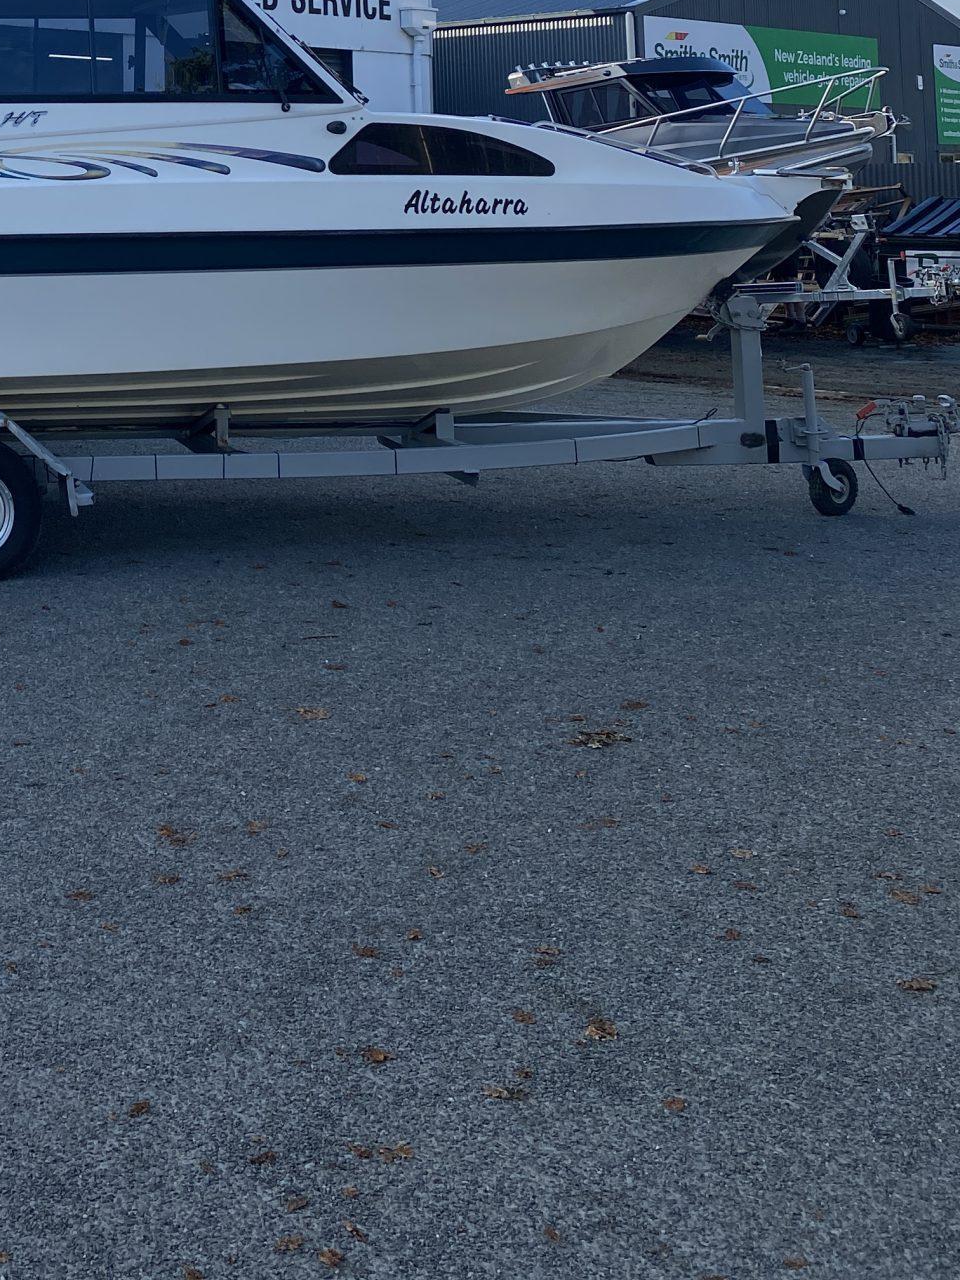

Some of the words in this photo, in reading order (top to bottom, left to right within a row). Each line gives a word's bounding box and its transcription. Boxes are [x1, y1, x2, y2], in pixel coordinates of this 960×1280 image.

[774, 48, 795, 64] New
[797, 50, 840, 67] Zealand's
[403, 189, 529, 216] Altaharra
